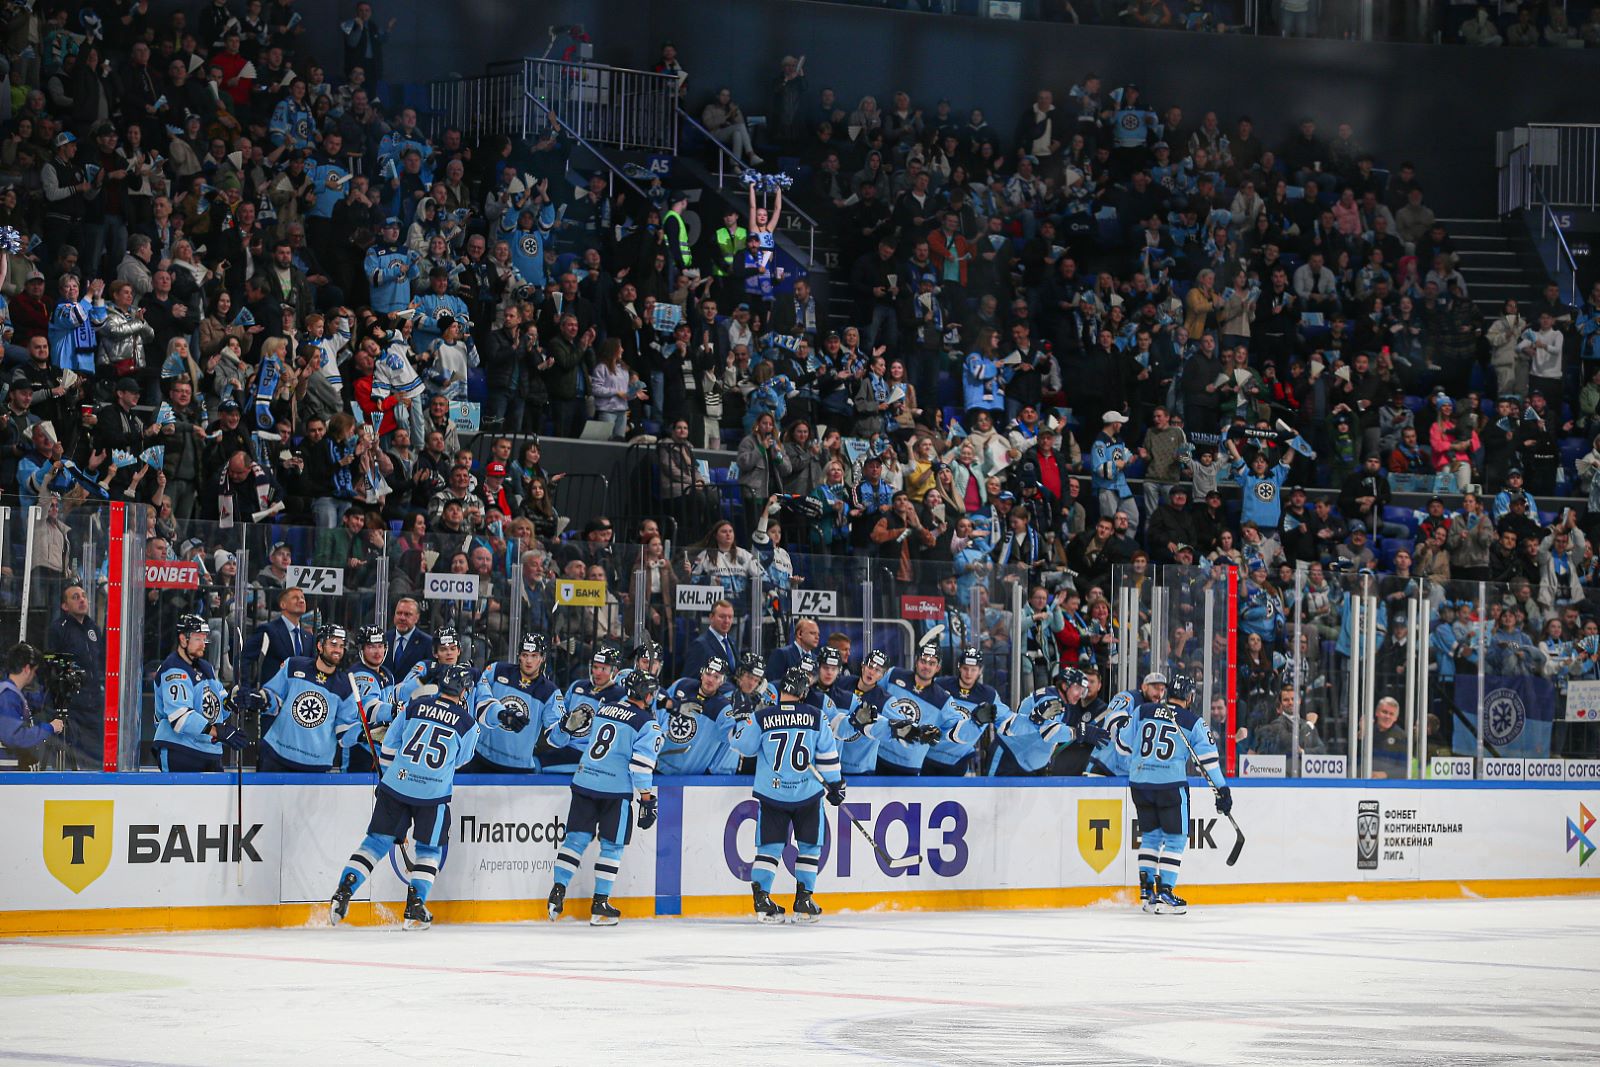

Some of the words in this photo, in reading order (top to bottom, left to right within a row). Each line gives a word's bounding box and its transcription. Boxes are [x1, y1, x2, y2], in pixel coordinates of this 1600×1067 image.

[786, 215, 801, 230] 14
[825, 253, 839, 268] 13
[575, 588, 600, 598] БАНК
[678, 590, 722, 606] KHL.RU
[169, 683, 188, 701] 91
[417, 704, 460, 726] PYANOV
[597, 705, 637, 721] MURPHY
[763, 713, 815, 730] AKHIYAROV
[402, 722, 456, 771] 45
[589, 722, 617, 761] 8
[1140, 721, 1178, 761] 85
[766, 731, 812, 773] 76
[1250, 764, 1282, 774] Ростелеком
[1384, 809, 1417, 820] ФОНБЕТ
[460, 815, 567, 849] Платосф
[1384, 823, 1463, 833] КОНТИНЕНТАЛЬНАЯ
[127, 824, 264, 864] БАНК
[1384, 835, 1433, 847] ХОККЕЙНАЯ
[1383, 850, 1404, 860] ЛИГА
[479, 858, 529, 873] Агрегатор
[531, 859, 555, 874] услу
